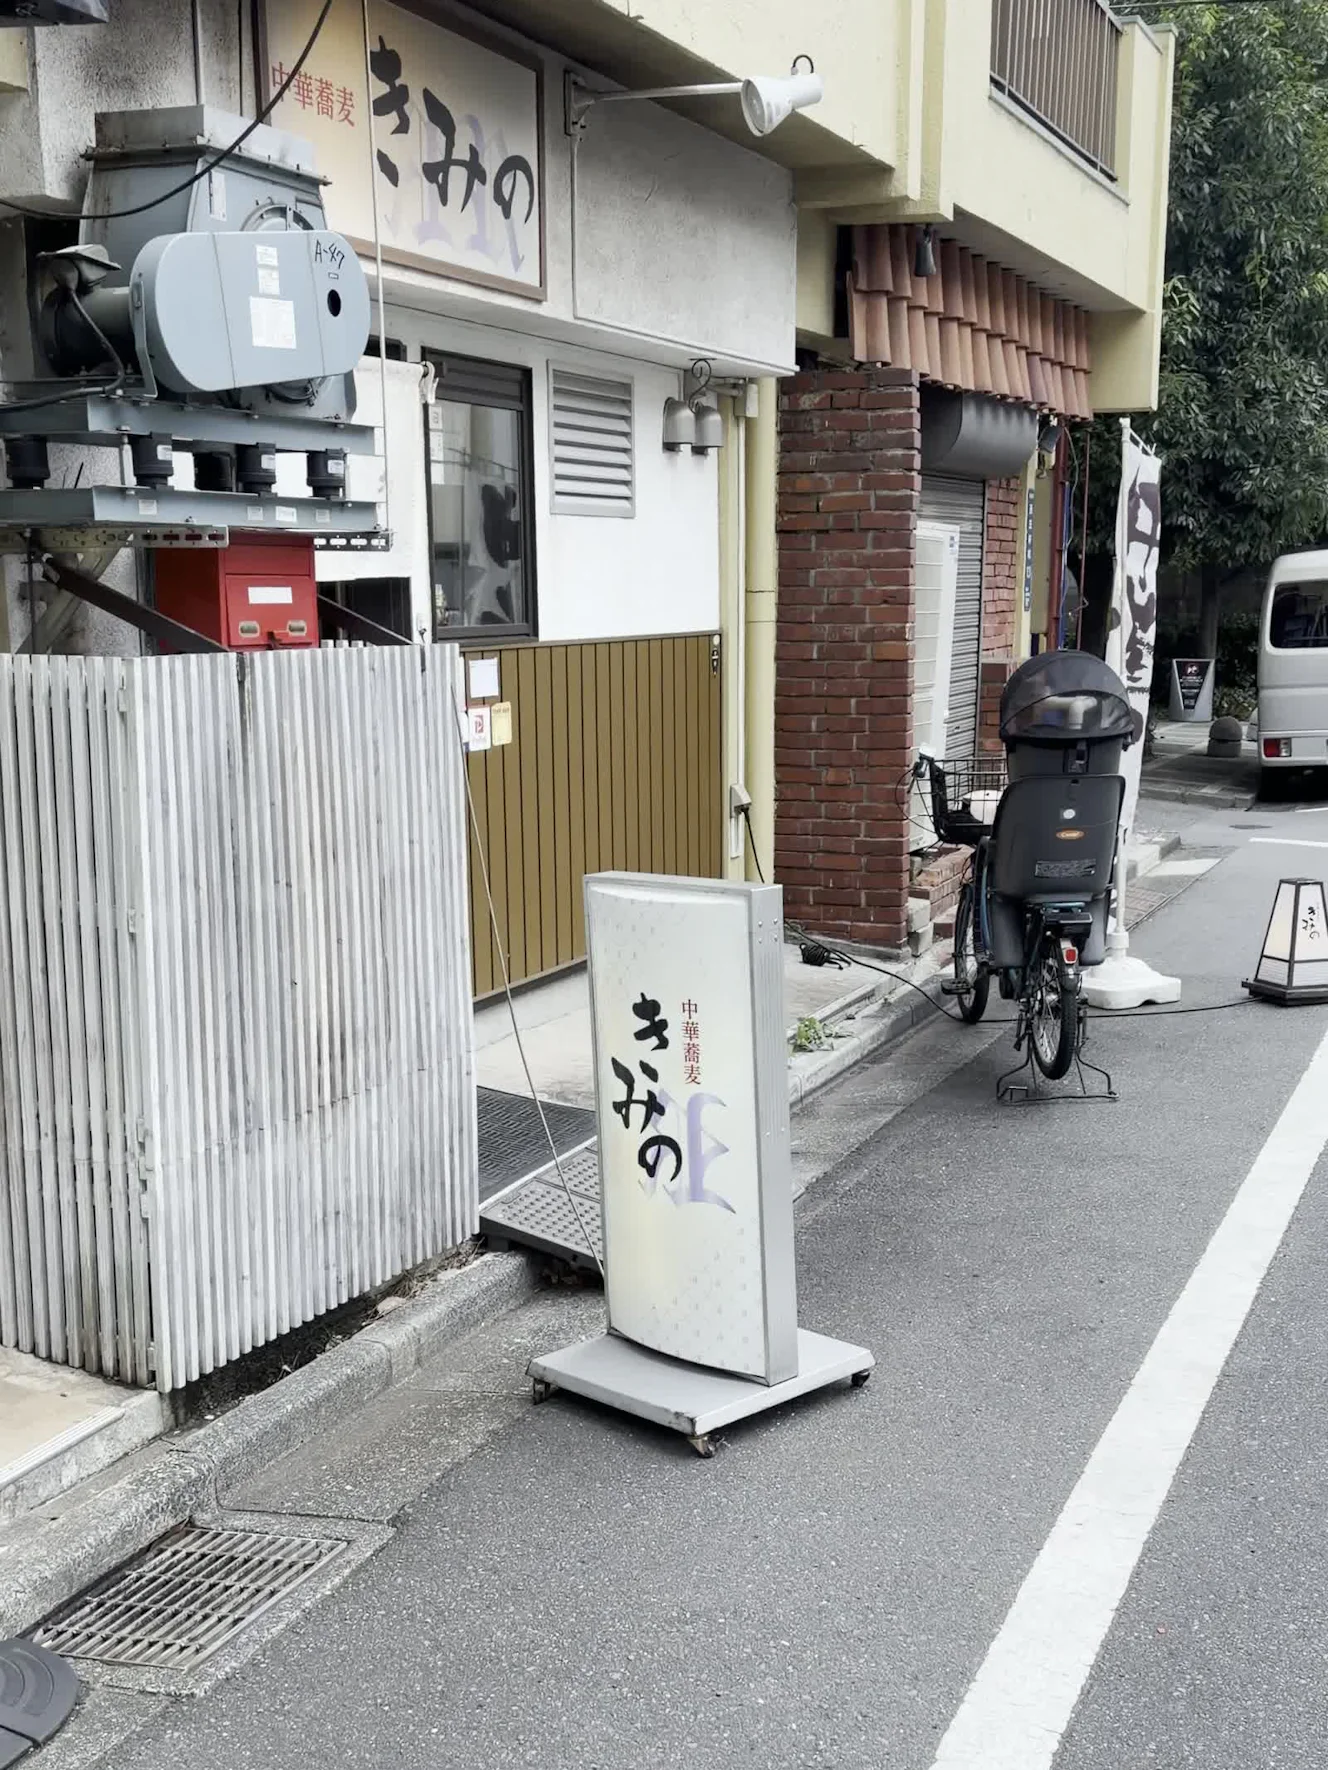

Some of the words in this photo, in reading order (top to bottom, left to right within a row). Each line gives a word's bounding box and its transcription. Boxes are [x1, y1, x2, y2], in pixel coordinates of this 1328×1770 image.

[271, 61, 355, 127] 中華蕎麦
[370, 35, 535, 225] きみの
[611, 992, 683, 1182] きみの
[682, 999, 701, 1085] 中華蕎麦
